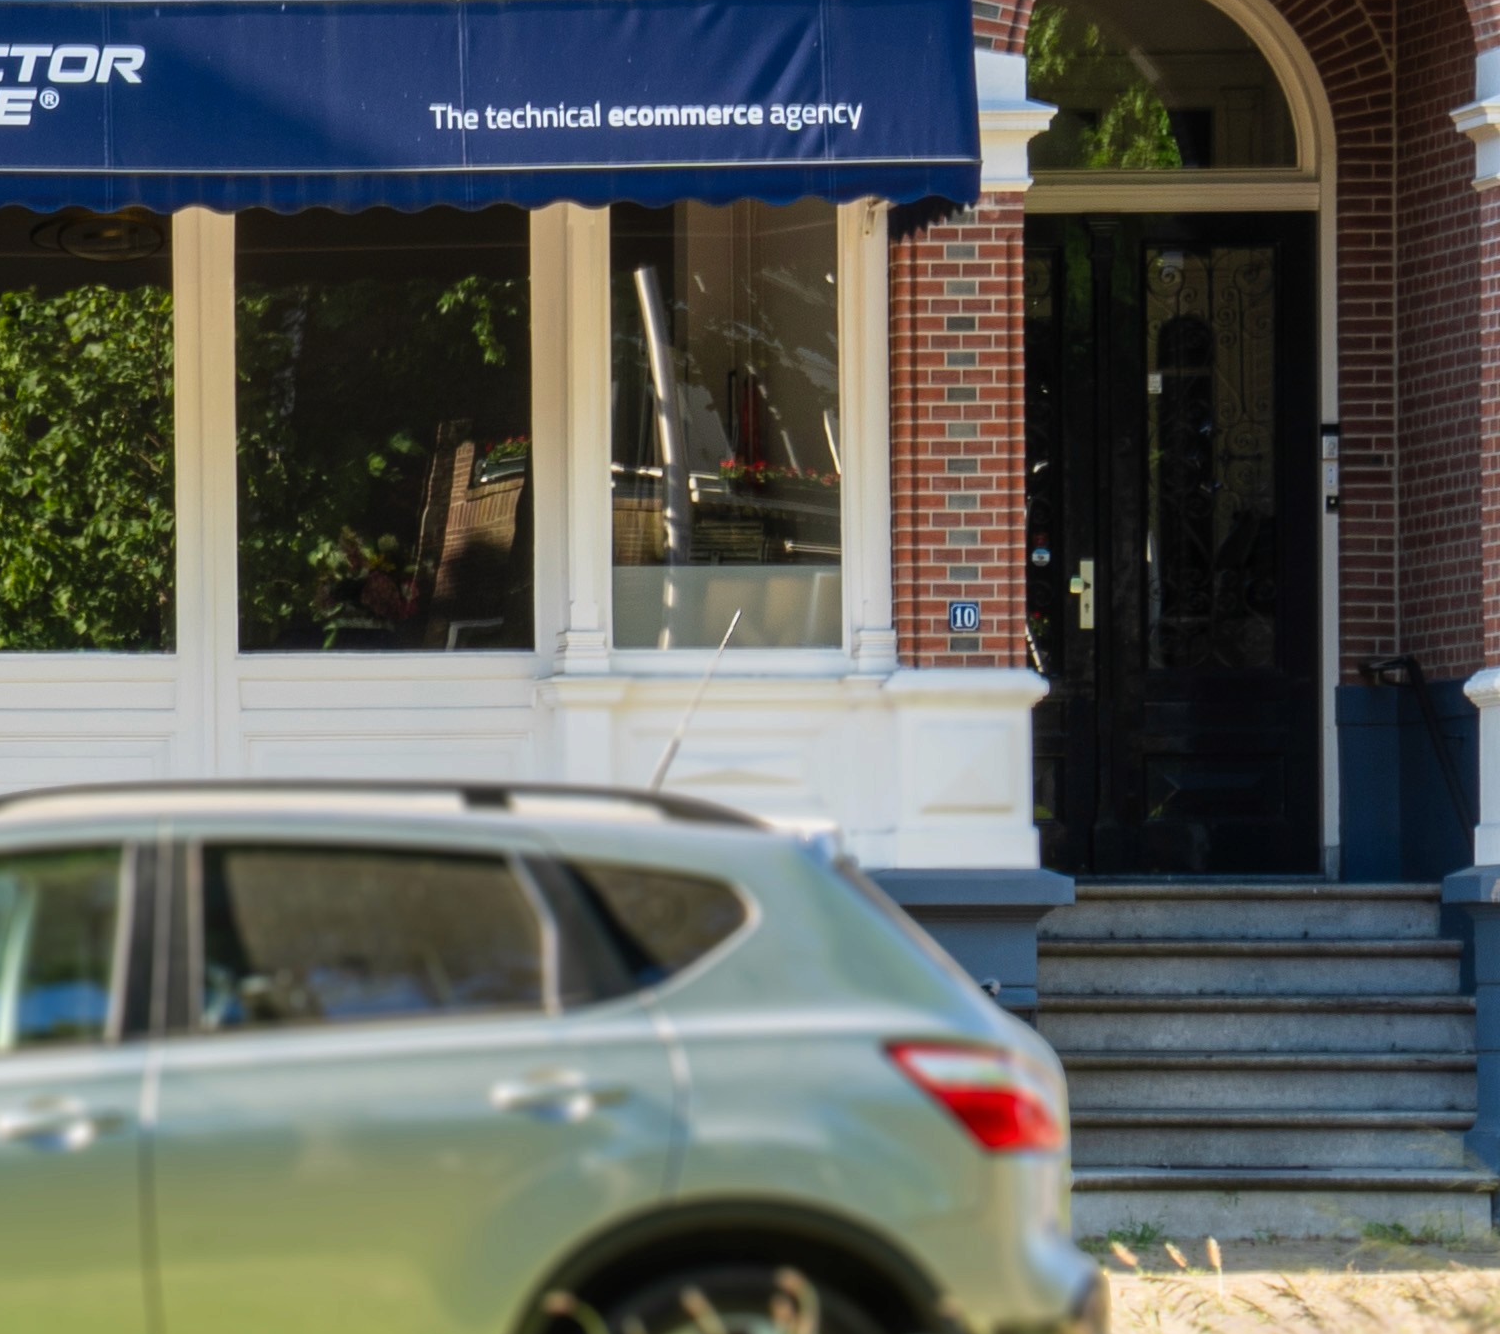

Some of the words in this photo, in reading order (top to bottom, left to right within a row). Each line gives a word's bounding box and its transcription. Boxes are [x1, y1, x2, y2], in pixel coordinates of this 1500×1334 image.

[429, 102, 479, 130] The
[485, 101, 601, 129] technical
[608, 104, 763, 127] ecommerce
[769, 102, 862, 130] agency
[954, 607, 976, 628] 10
